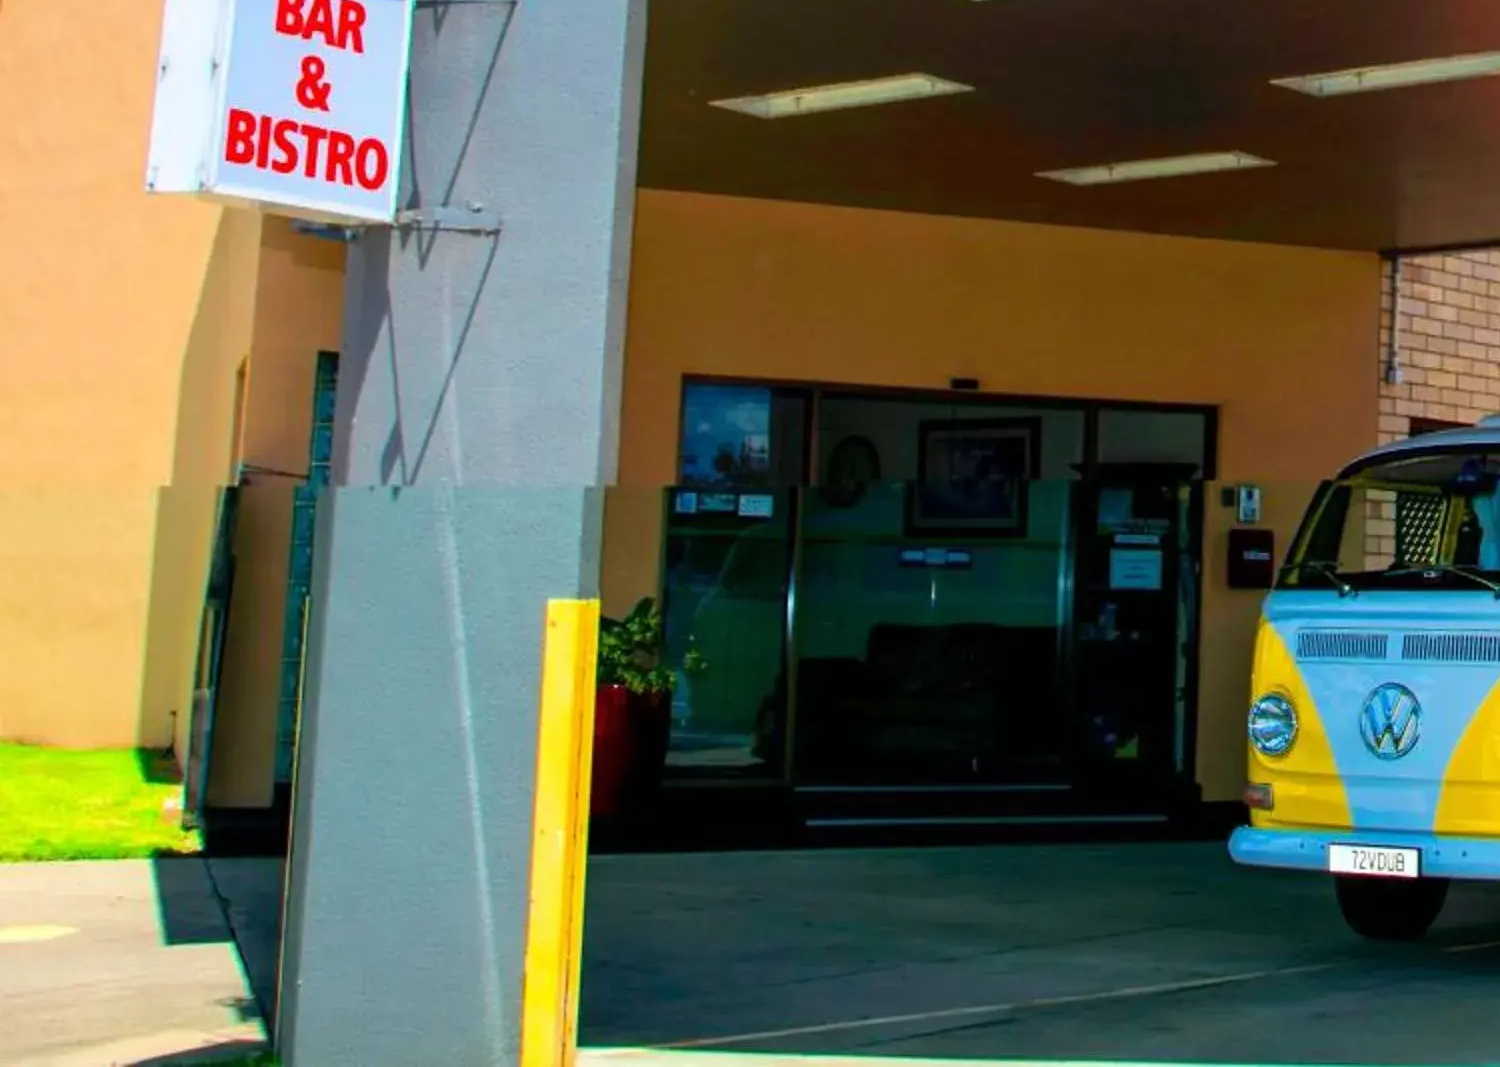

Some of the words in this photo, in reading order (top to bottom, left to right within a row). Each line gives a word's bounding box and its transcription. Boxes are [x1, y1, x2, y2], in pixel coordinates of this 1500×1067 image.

[295, 55, 332, 112] &
[225, 108, 388, 192] BISTRO
[1351, 850, 1405, 873] 72VDUB
